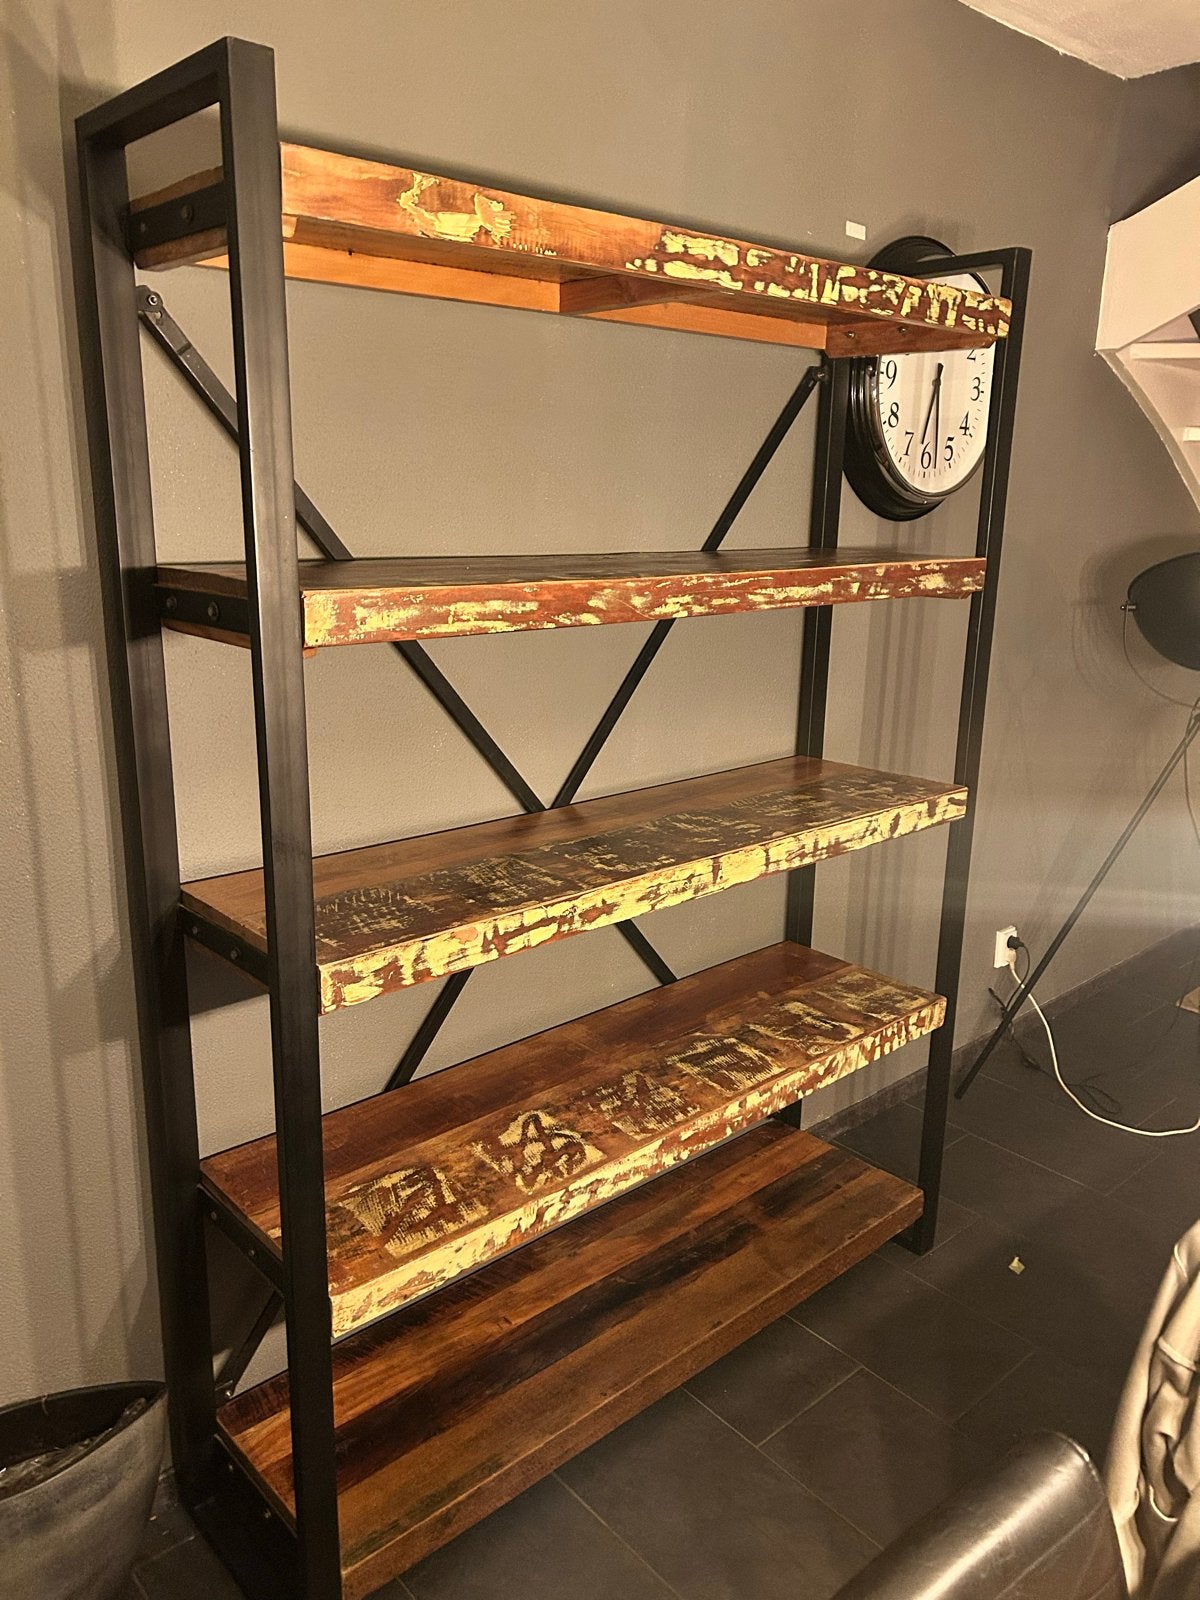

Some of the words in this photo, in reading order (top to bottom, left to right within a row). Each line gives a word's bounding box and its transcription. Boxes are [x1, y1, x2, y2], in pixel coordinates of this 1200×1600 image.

[886, 360, 898, 389] 9
[970, 377, 981, 401] 3
[888, 402, 899, 428] 8
[959, 411, 970, 436] 4
[904, 431, 915, 456] 7
[920, 441, 932, 470] 6
[944, 437, 955, 462] 5
